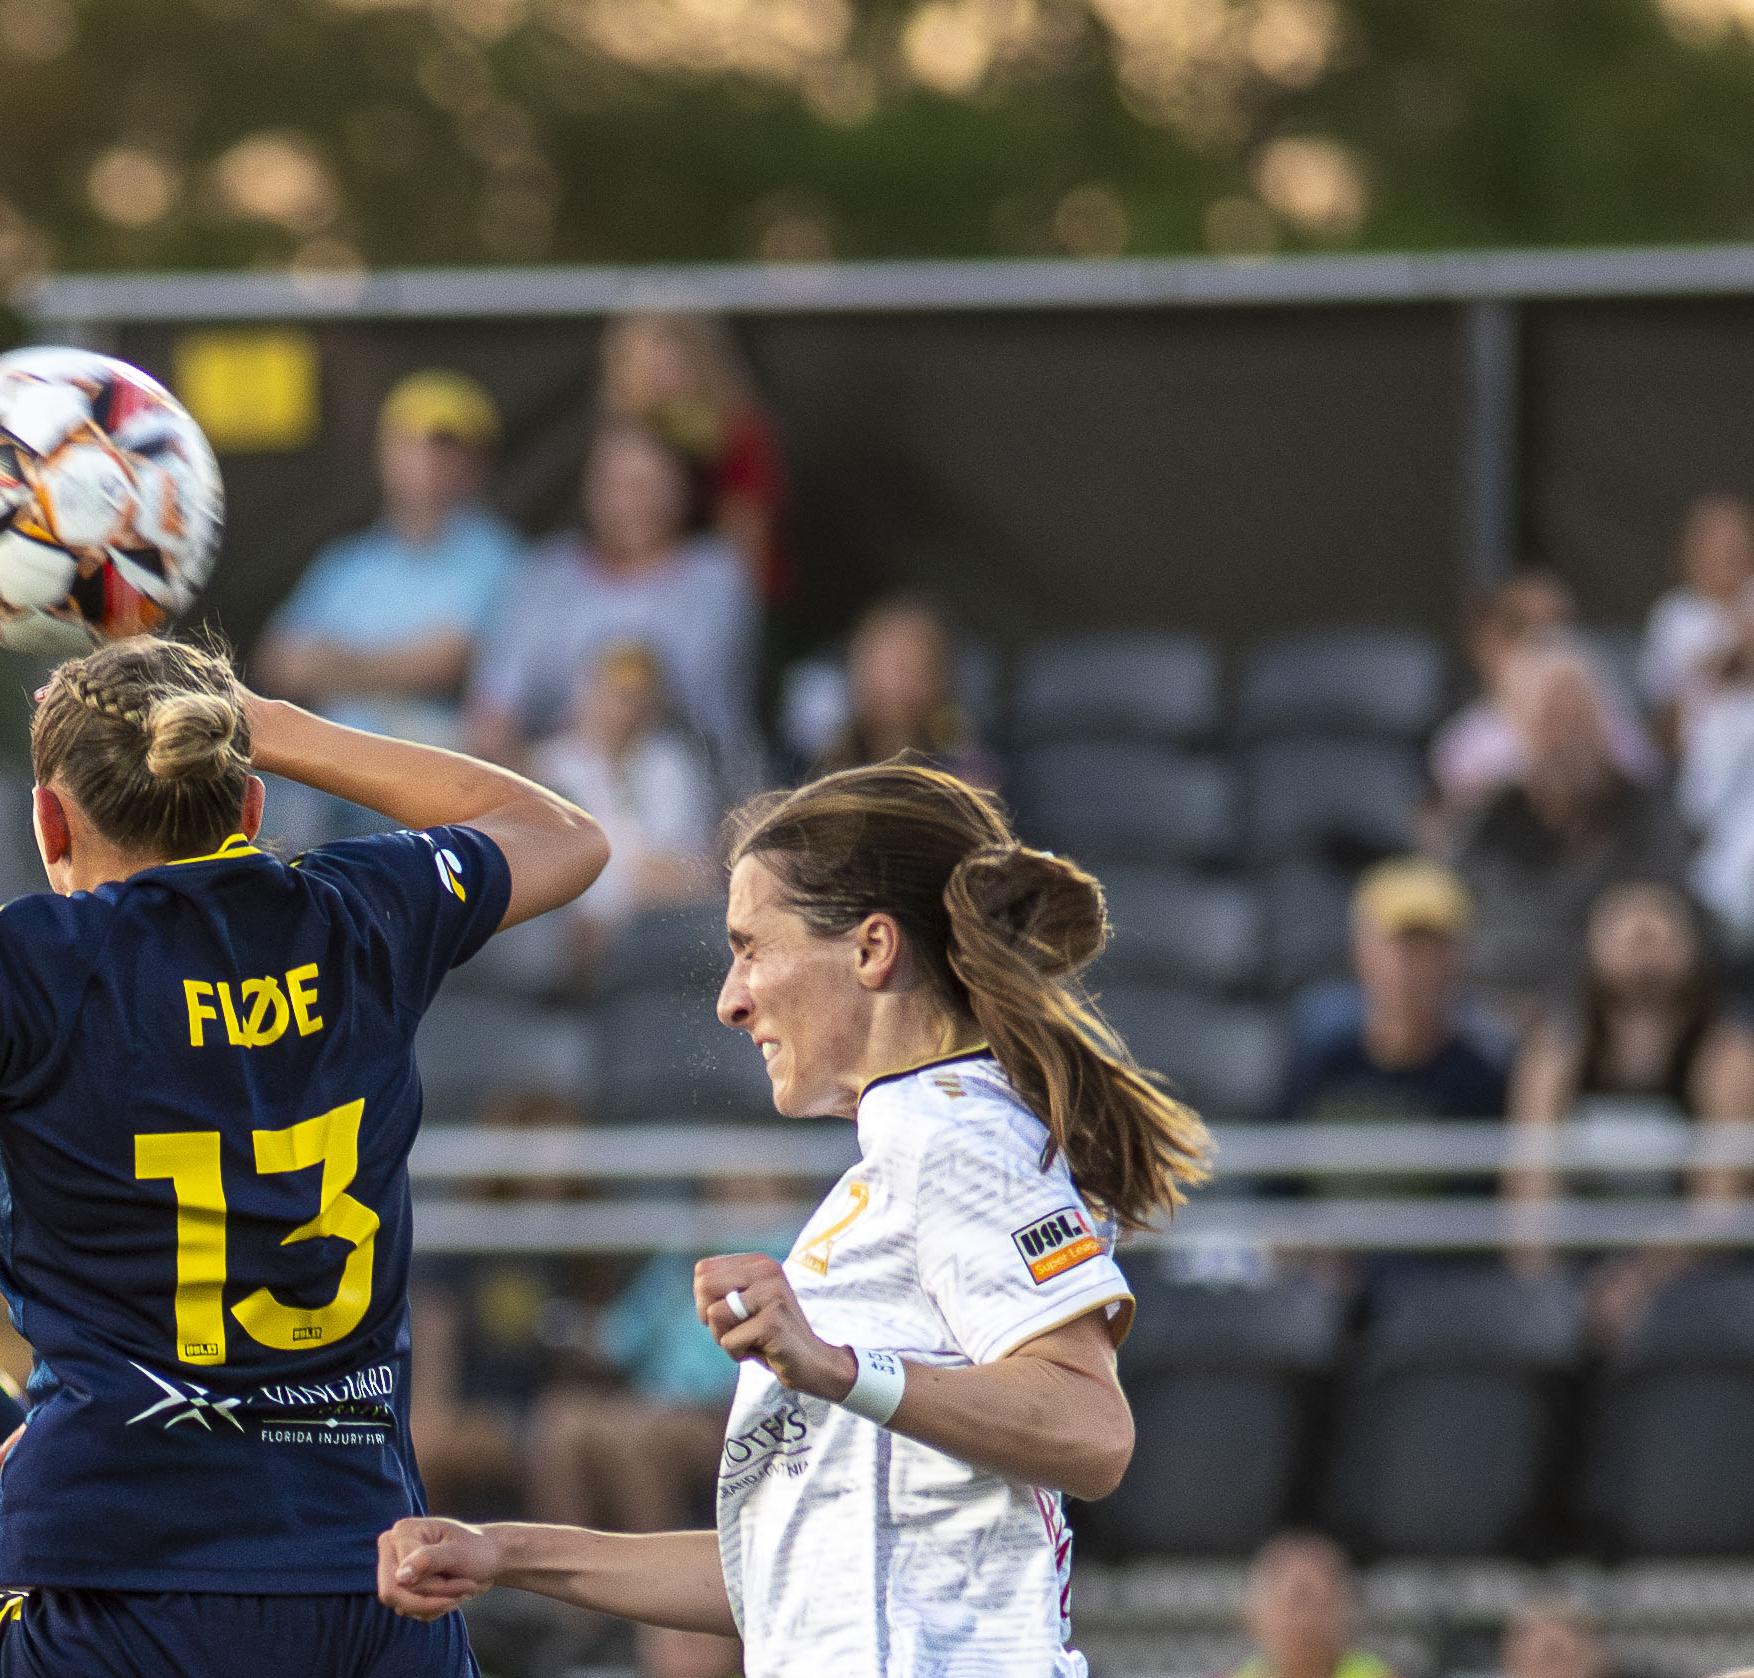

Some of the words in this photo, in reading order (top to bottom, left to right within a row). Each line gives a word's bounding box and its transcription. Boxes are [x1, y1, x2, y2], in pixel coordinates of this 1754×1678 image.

[183, 963, 324, 1049] FLØE
[134, 1098, 380, 1365] 13
[260, 1365, 393, 1405] VANGUARD
[261, 1430, 313, 1443] FLORIDA
[319, 1432, 364, 1445] INJURY
[724, 1408, 808, 1468] OTELS
